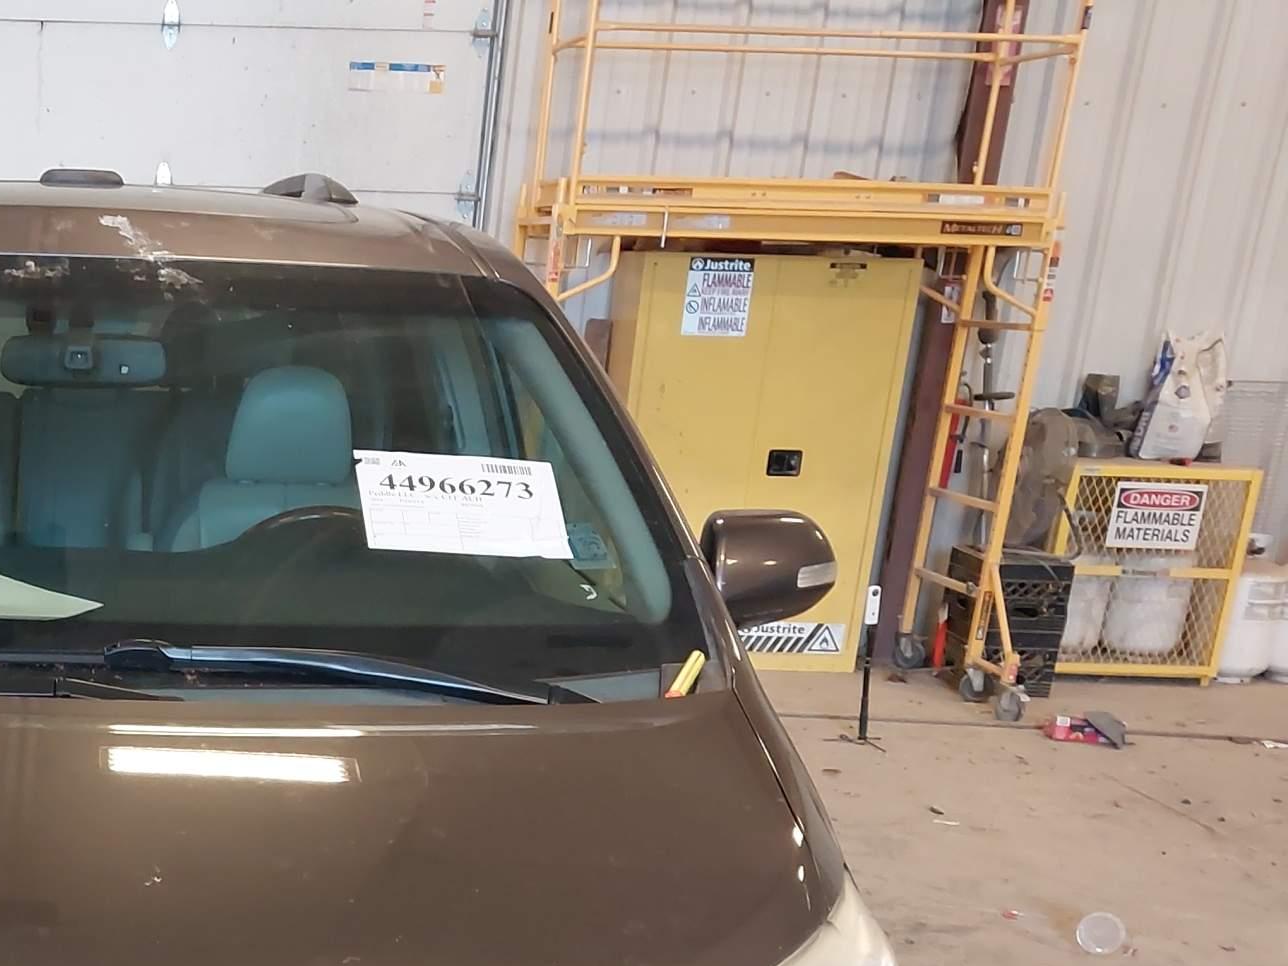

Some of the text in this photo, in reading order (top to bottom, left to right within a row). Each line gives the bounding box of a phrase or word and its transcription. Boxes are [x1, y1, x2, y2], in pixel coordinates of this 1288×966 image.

[704, 258, 752, 271] Justrite
[702, 272, 753, 289] FLAMMABLE
[379, 472, 534, 500] 44966273
[1129, 493, 1191, 507] DANGER
[1115, 510, 1197, 527] FLAMMABLE
[1114, 527, 1191, 543] MATERIALS
[753, 623, 805, 635] Justrite
